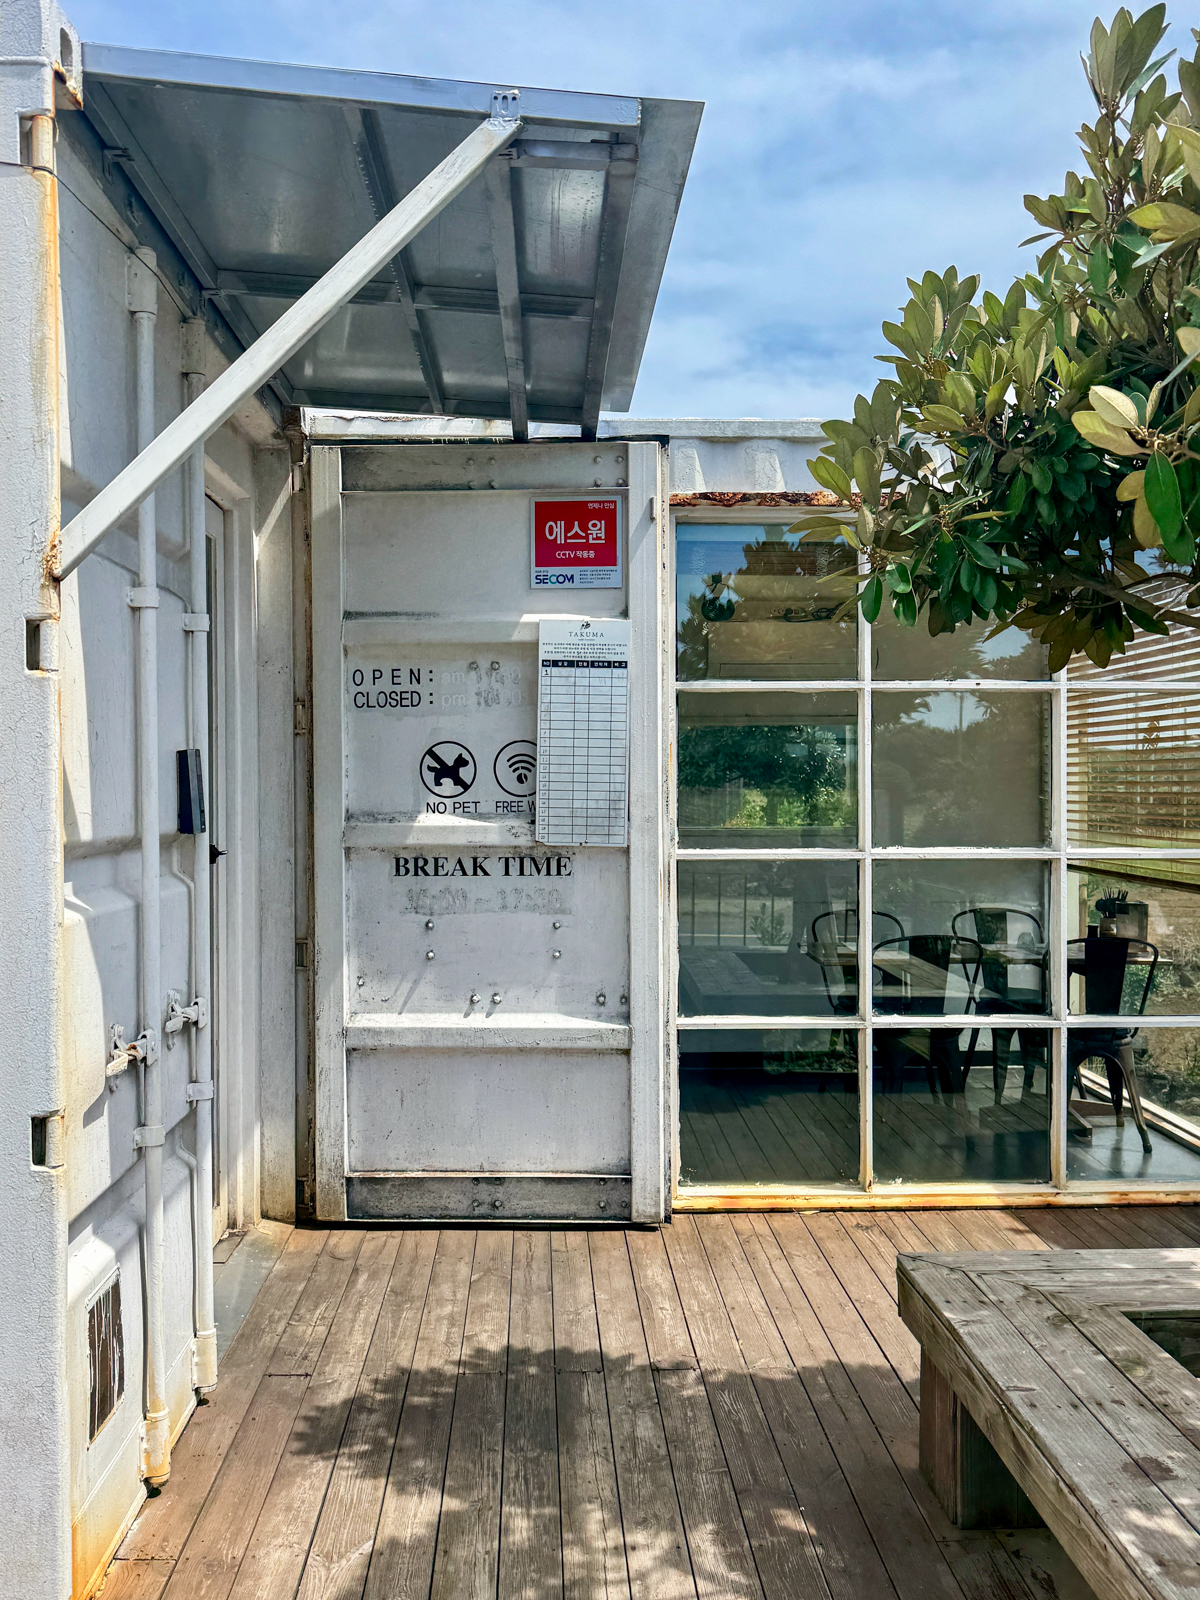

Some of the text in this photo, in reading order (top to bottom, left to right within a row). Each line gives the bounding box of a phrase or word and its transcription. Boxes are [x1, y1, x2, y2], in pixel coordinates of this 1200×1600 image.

[545, 520, 606, 544] 에스원
[555, 550, 596, 559] CCTV 작동중
[535, 573, 575, 585] SECOM
[426, 801, 481, 814] NO PET
[495, 800, 524, 813] FREE
[393, 856, 573, 877] BREAK TIME
